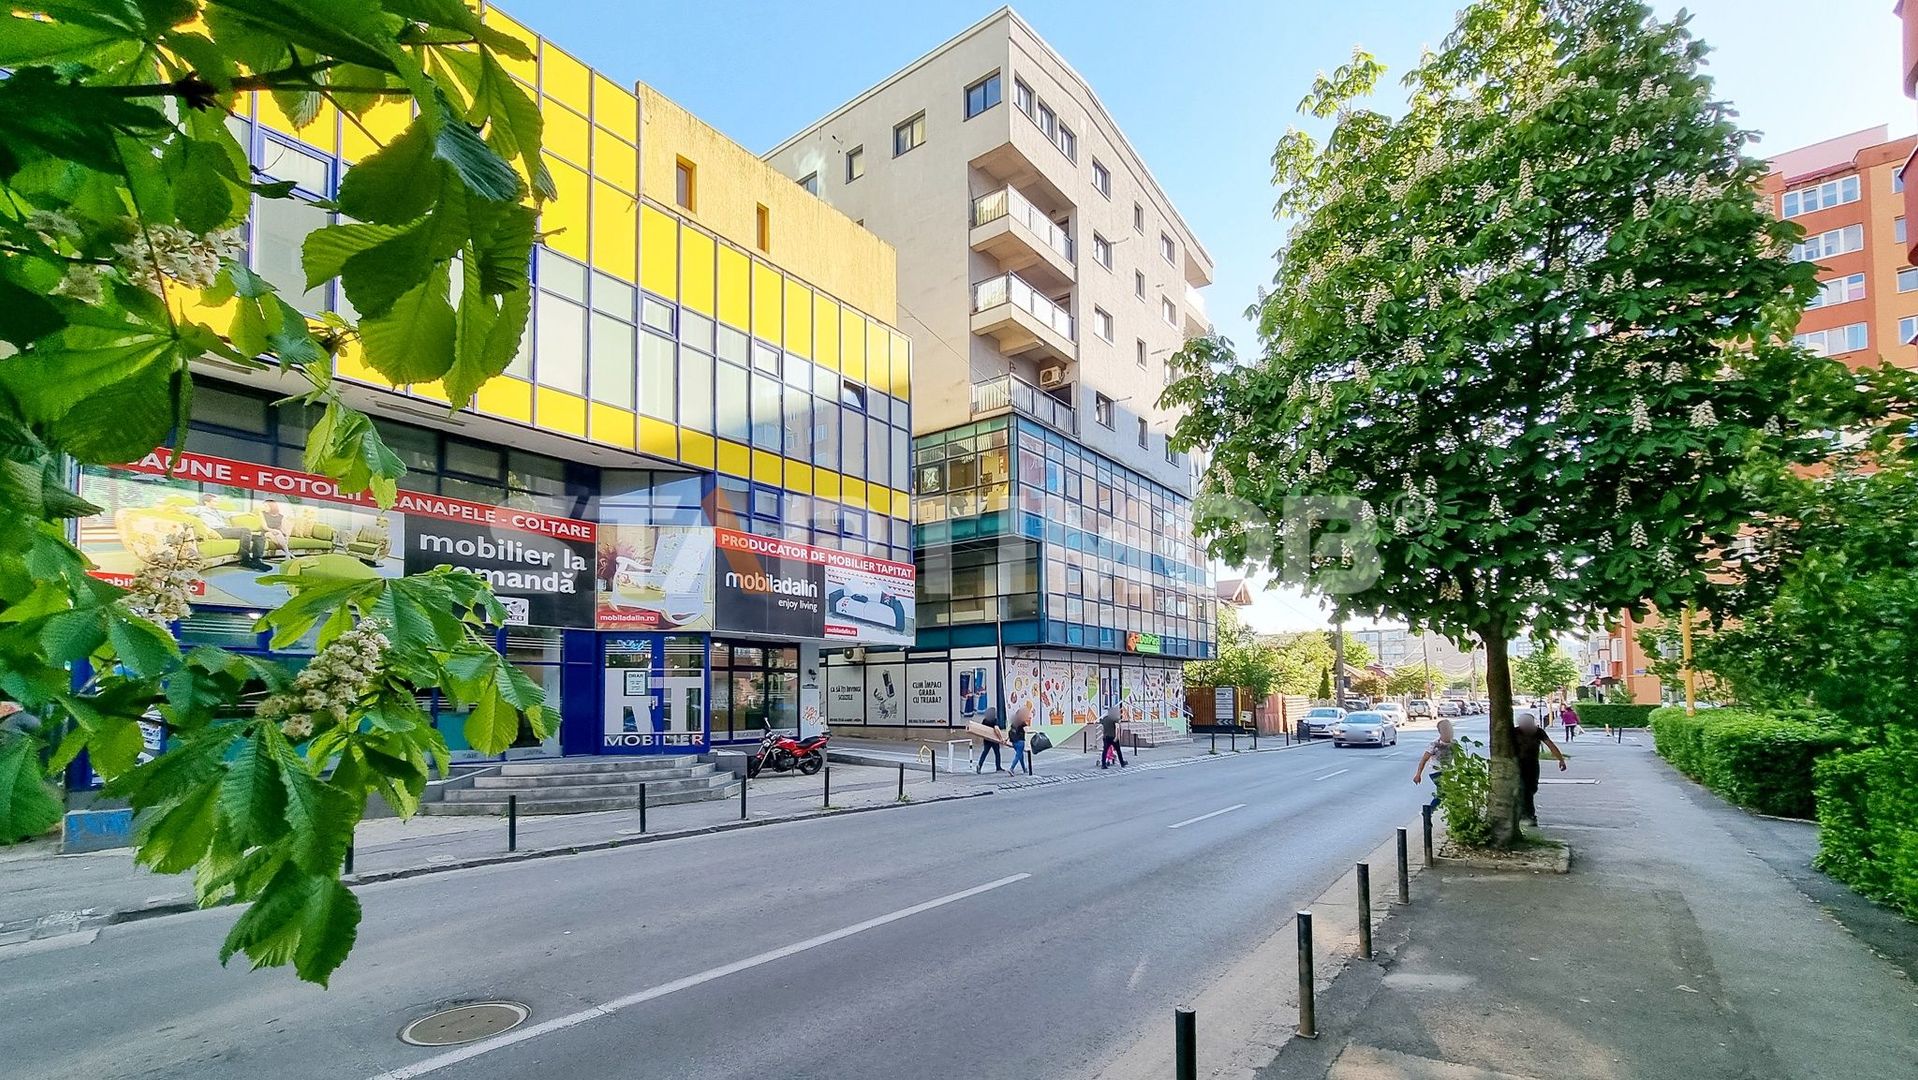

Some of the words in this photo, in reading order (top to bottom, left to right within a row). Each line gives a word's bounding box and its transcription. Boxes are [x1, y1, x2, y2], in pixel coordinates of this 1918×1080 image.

[394, 496, 496, 523] ANAPELE
[420, 533, 555, 567] mobilier
[564, 548, 588, 571] la
[721, 534, 808, 560] PRODUCATOR
[811, 551, 825, 563] DE
[828, 554, 875, 571] MOBILIER
[877, 564, 913, 578] TAPITAT
[725, 570, 818, 598] mobiladalin
[778, 599, 799, 611] enjoy
[800, 601, 818, 612] living
[600, 614, 656, 622] mobiladalin.ro
[912, 696, 919, 704] CU
[604, 734, 705, 747] MOBILIER
